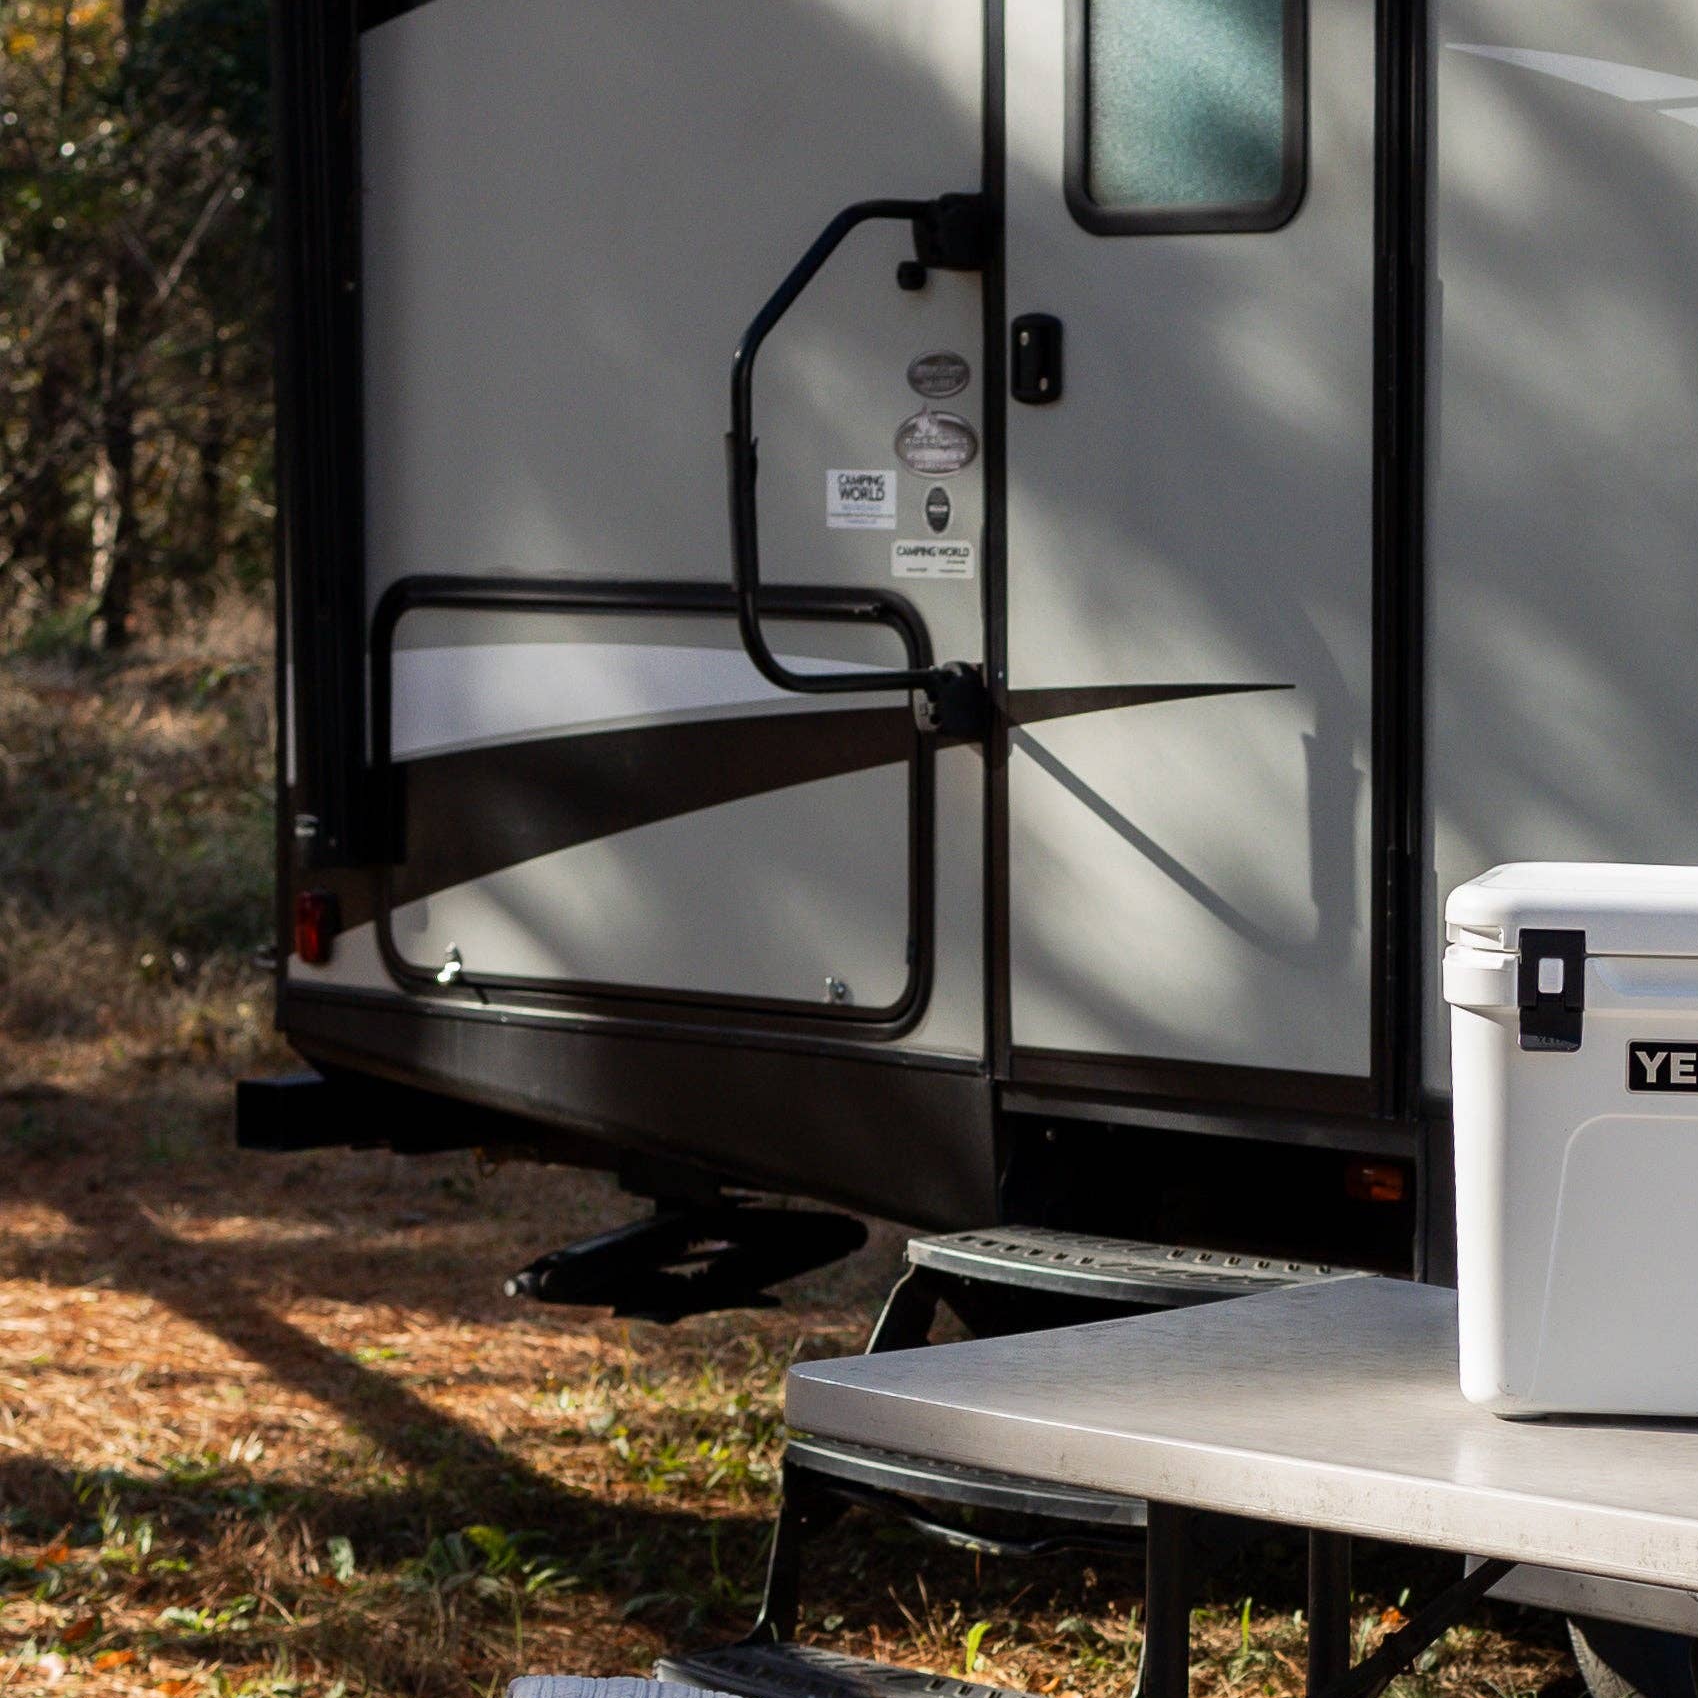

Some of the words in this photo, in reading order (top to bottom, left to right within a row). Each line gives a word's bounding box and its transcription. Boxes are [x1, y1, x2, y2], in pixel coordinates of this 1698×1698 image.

[838, 474, 885, 487] CAMPING
[839, 486, 885, 502] WORLD
[896, 545, 936, 557] CAMPING
[938, 546, 970, 558] WORLD
